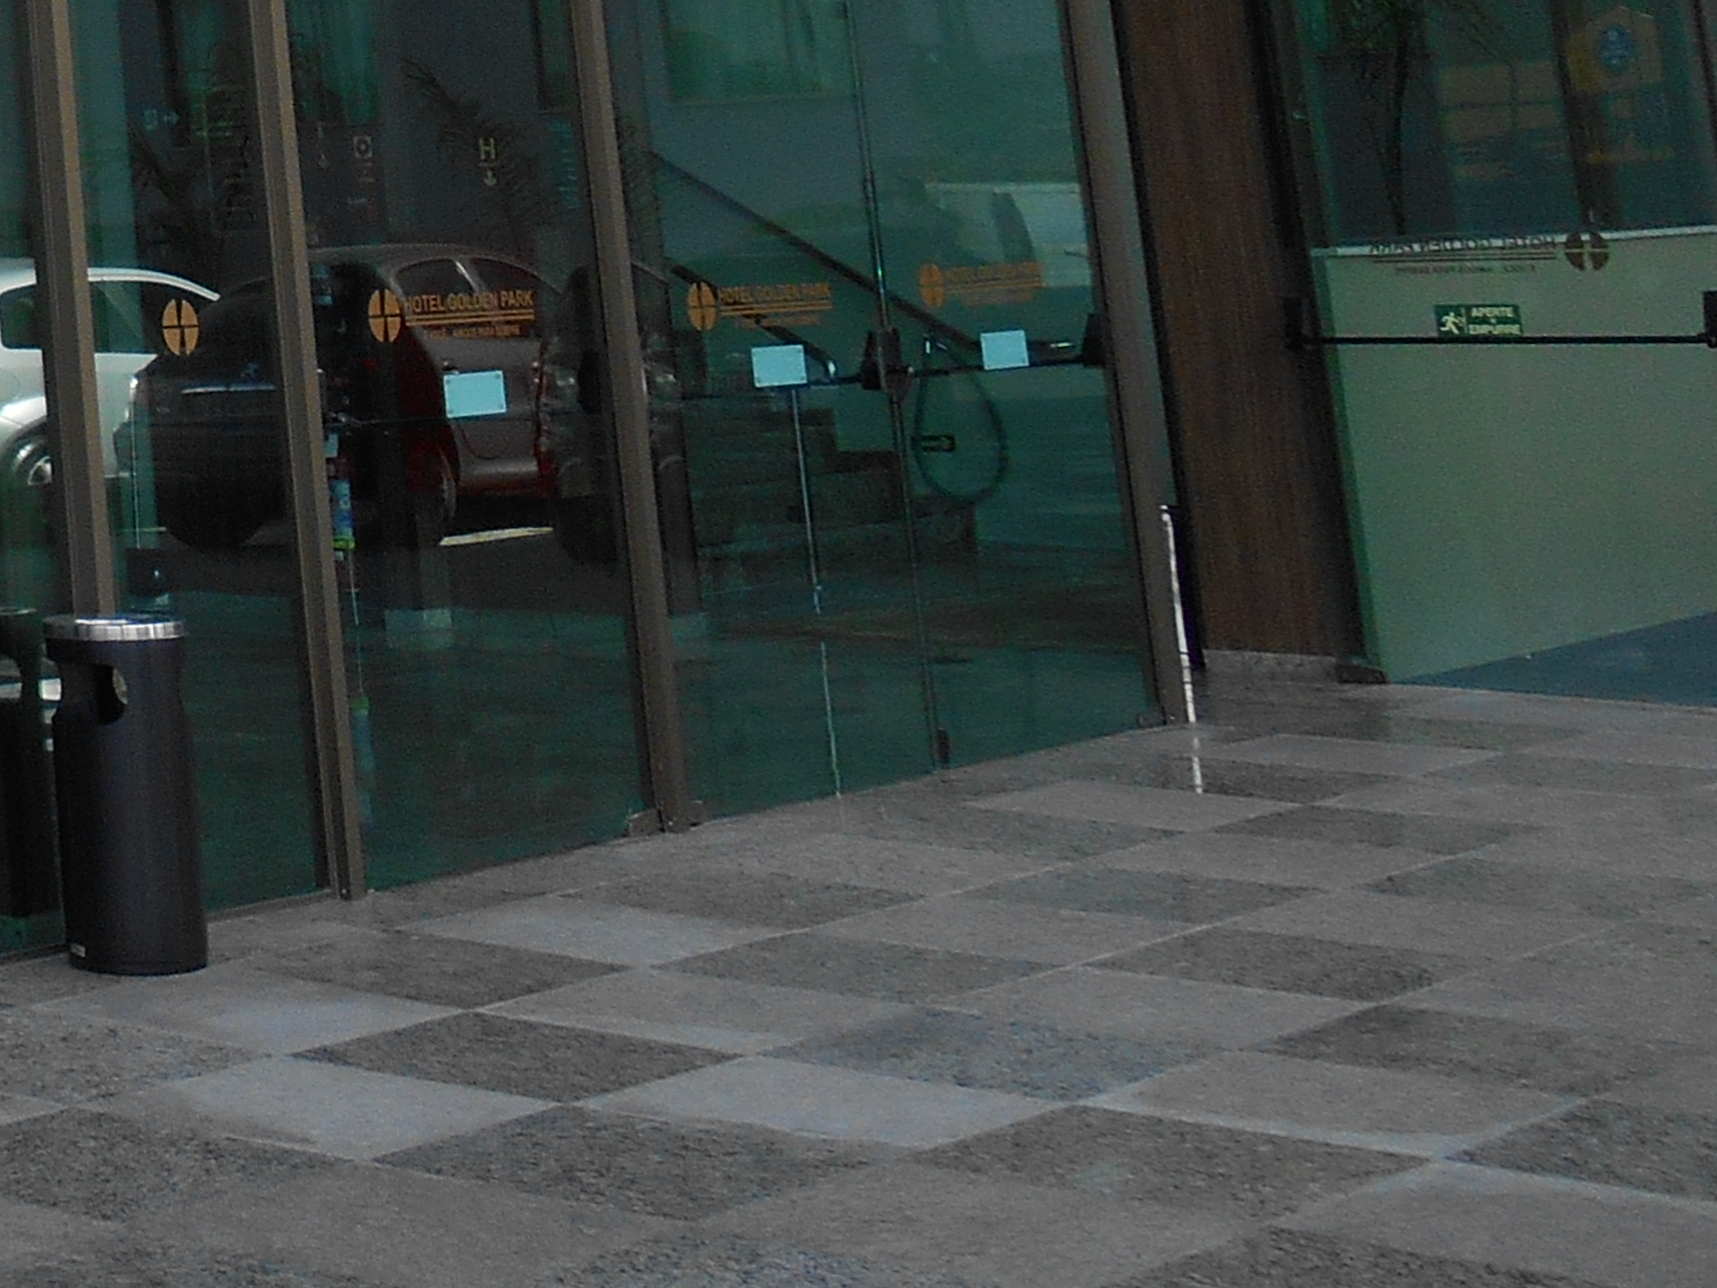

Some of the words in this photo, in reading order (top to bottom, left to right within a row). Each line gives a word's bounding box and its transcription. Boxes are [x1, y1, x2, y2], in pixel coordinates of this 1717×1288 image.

[404, 294, 447, 313] HOTEL
[447, 291, 498, 312] GOLDEN
[501, 289, 534, 308] PARK
